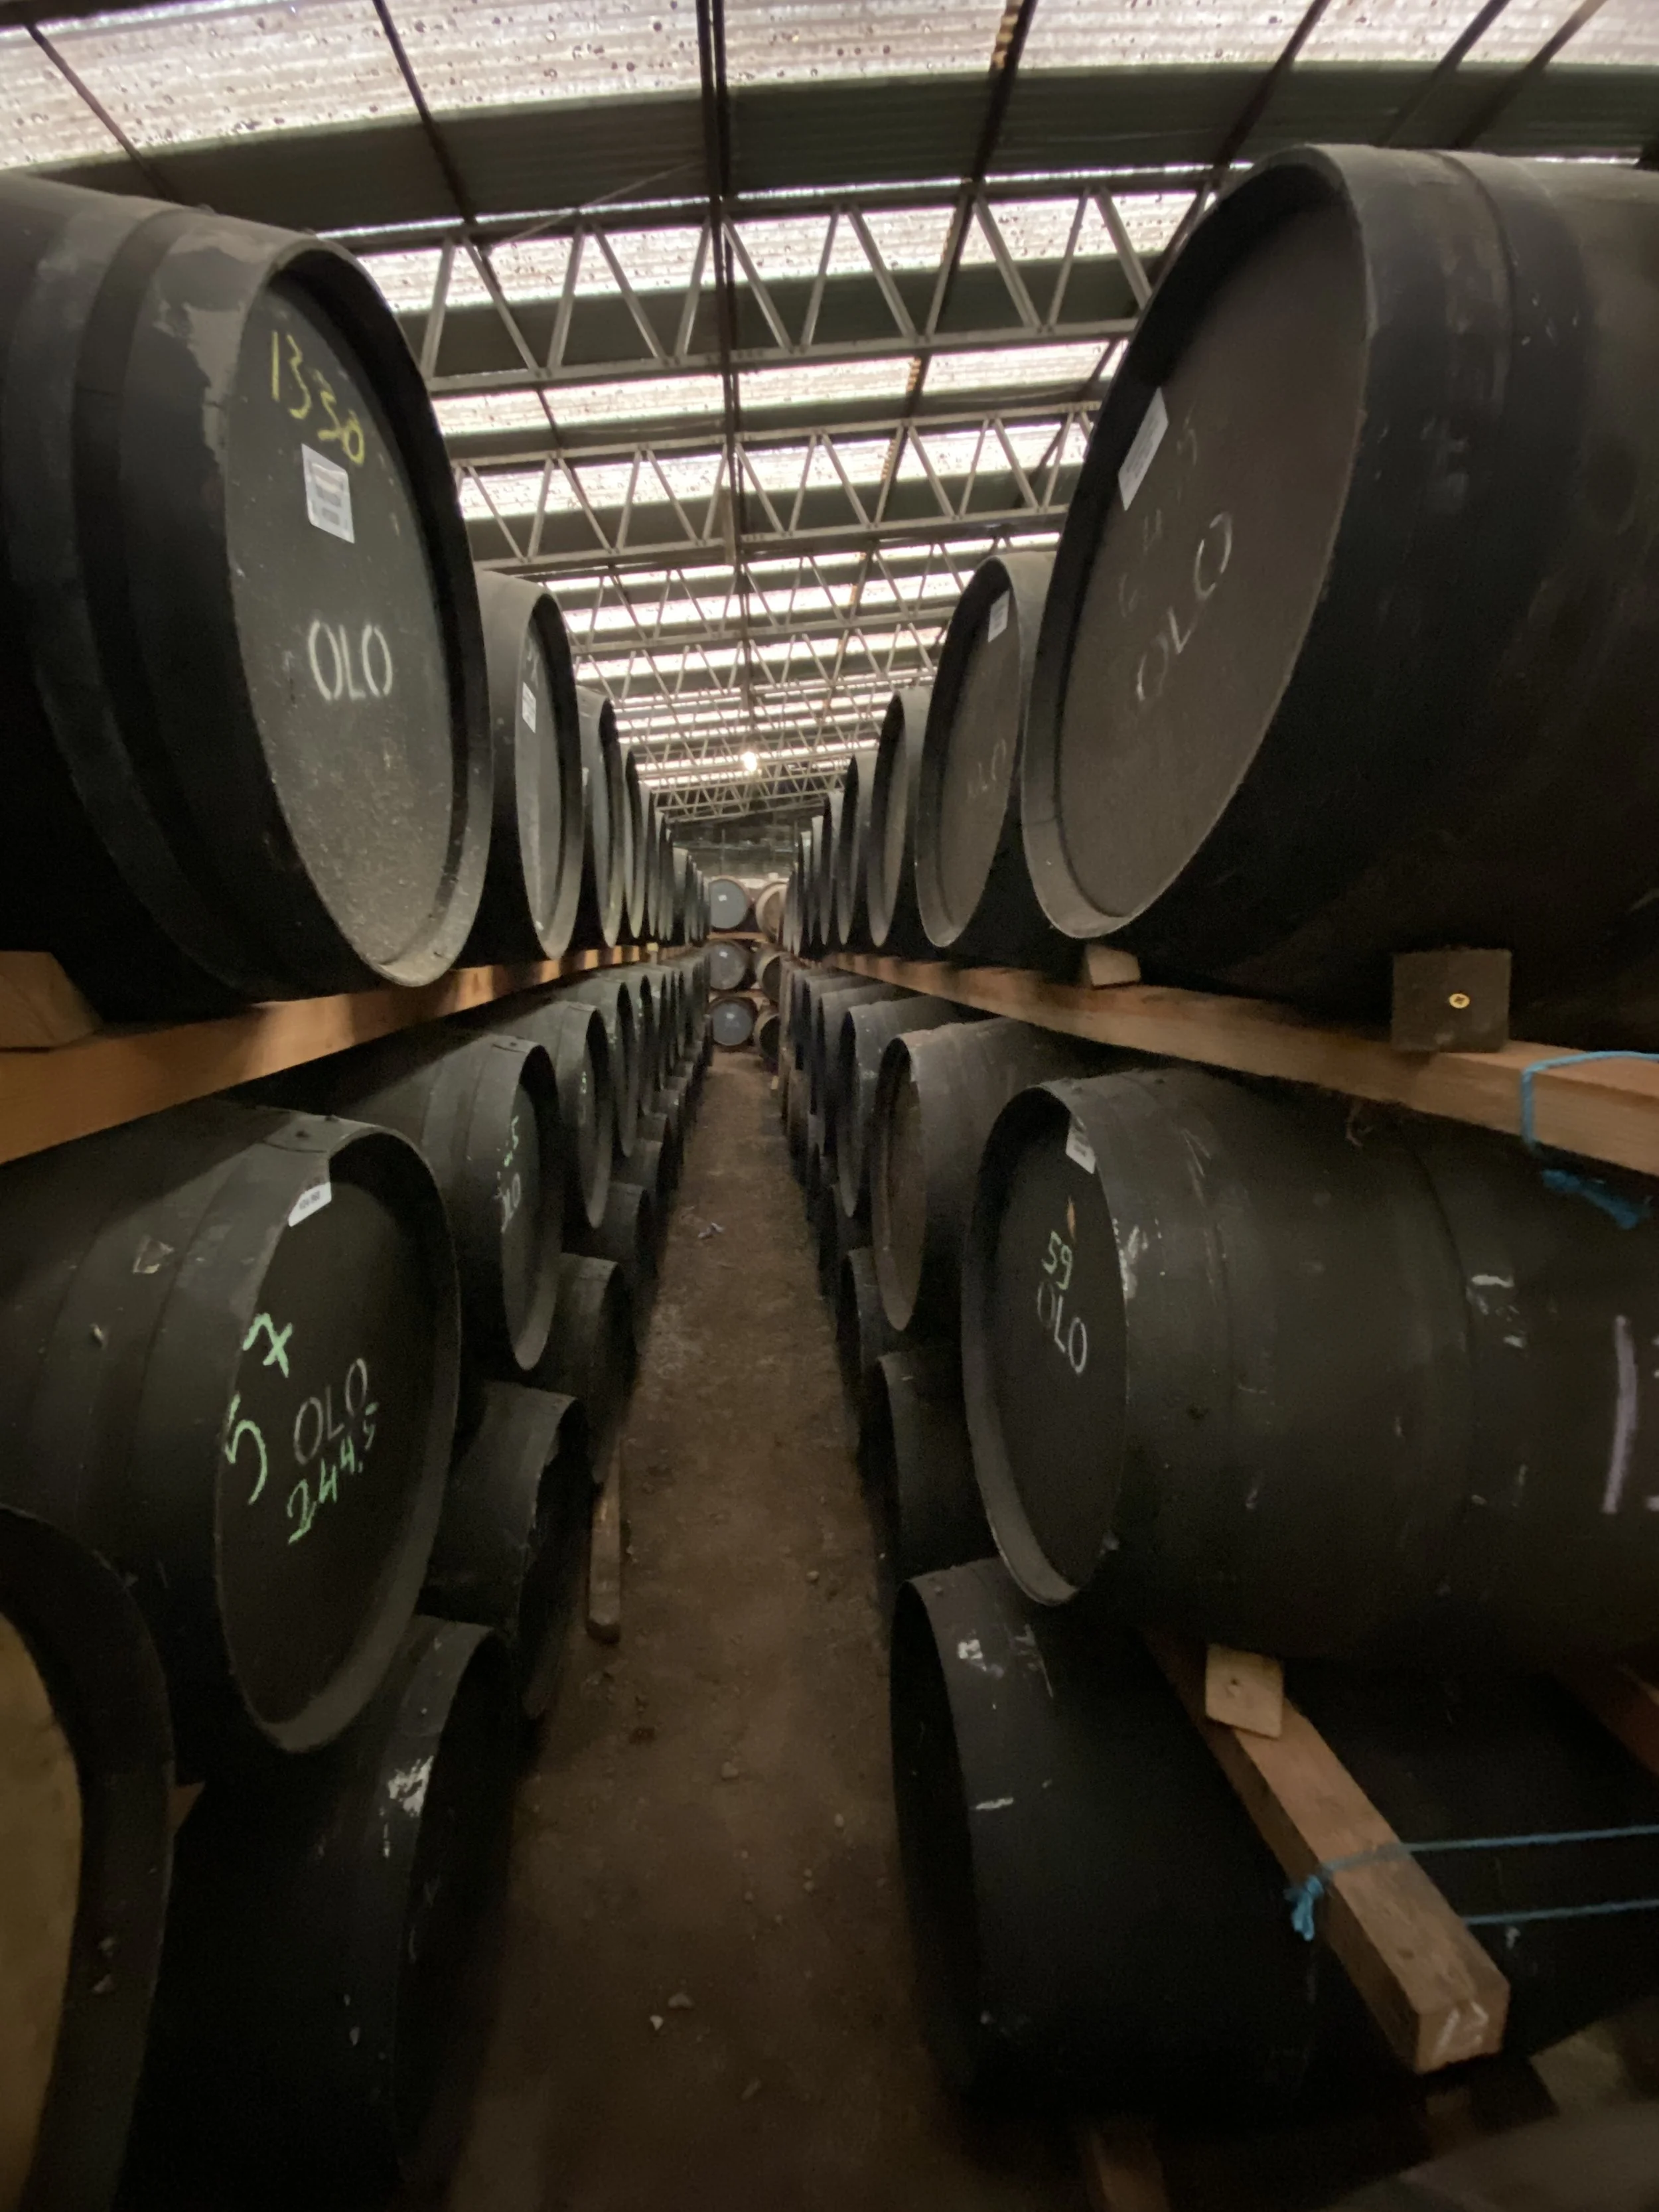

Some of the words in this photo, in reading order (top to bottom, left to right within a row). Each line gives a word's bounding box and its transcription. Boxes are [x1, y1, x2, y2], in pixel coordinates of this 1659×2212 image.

[1135, 510, 1233, 702] OLO
[307, 620, 393, 700] OLO
[1037, 1280, 1088, 1375] OLO
[293, 1358, 368, 1465] OLO
